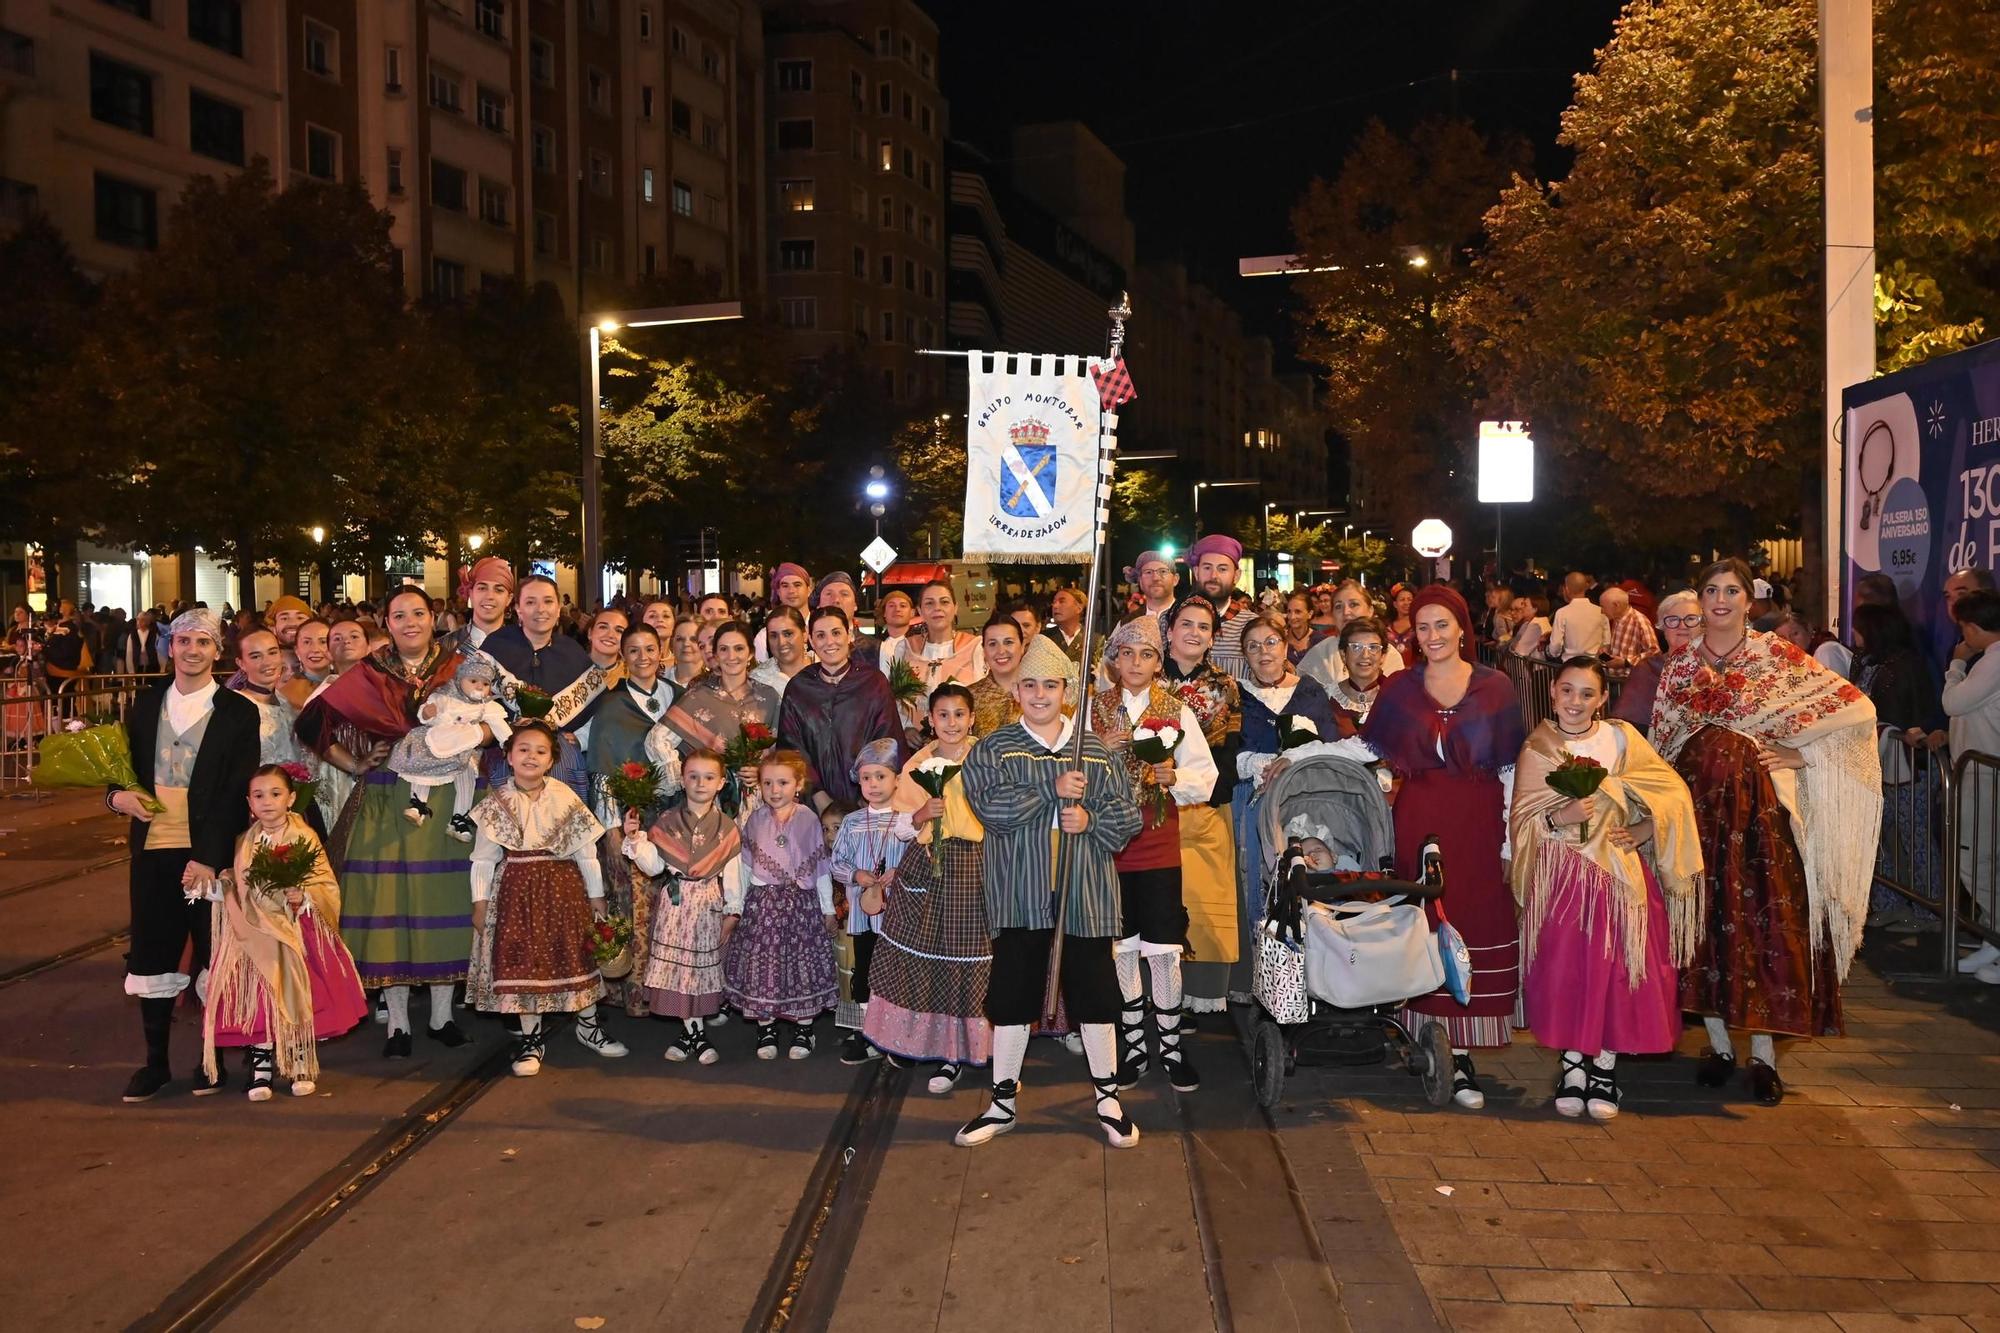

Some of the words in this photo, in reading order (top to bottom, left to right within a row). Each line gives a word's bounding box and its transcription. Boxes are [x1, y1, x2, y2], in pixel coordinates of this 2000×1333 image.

[978, 396, 1011, 427] GRUPO
[988, 514, 1019, 538] URREA
[1020, 529, 1033, 539] DE
[1035, 515, 1067, 538] JALON
[1882, 508, 1914, 525] PULSERA
[1914, 507, 1928, 520] 150
[1881, 521, 1929, 539] ANIVERSARIO
[1892, 549, 1917, 567] 6,95€
[1948, 521, 1977, 575] de
